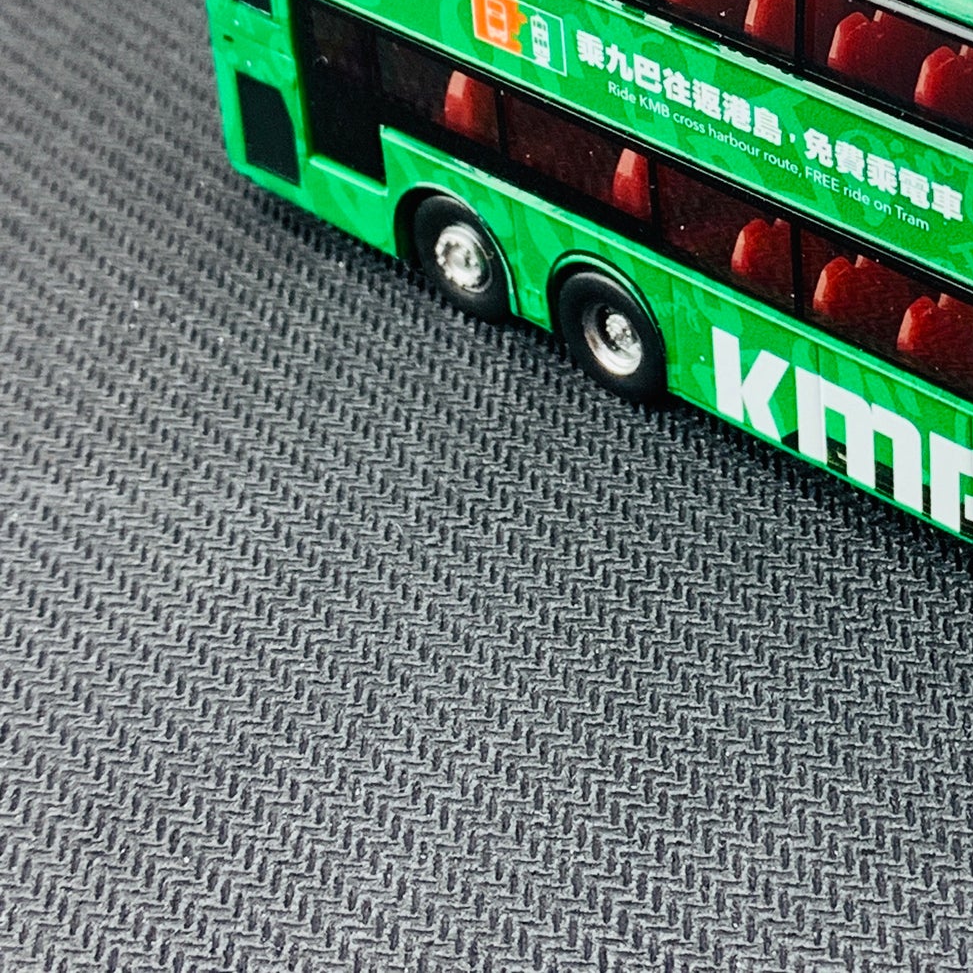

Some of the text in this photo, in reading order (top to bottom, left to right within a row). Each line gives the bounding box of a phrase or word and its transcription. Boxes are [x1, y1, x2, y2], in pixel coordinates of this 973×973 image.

[608, 80, 930, 232] Ride KMB cross harbour route, FREE ride on Tram
